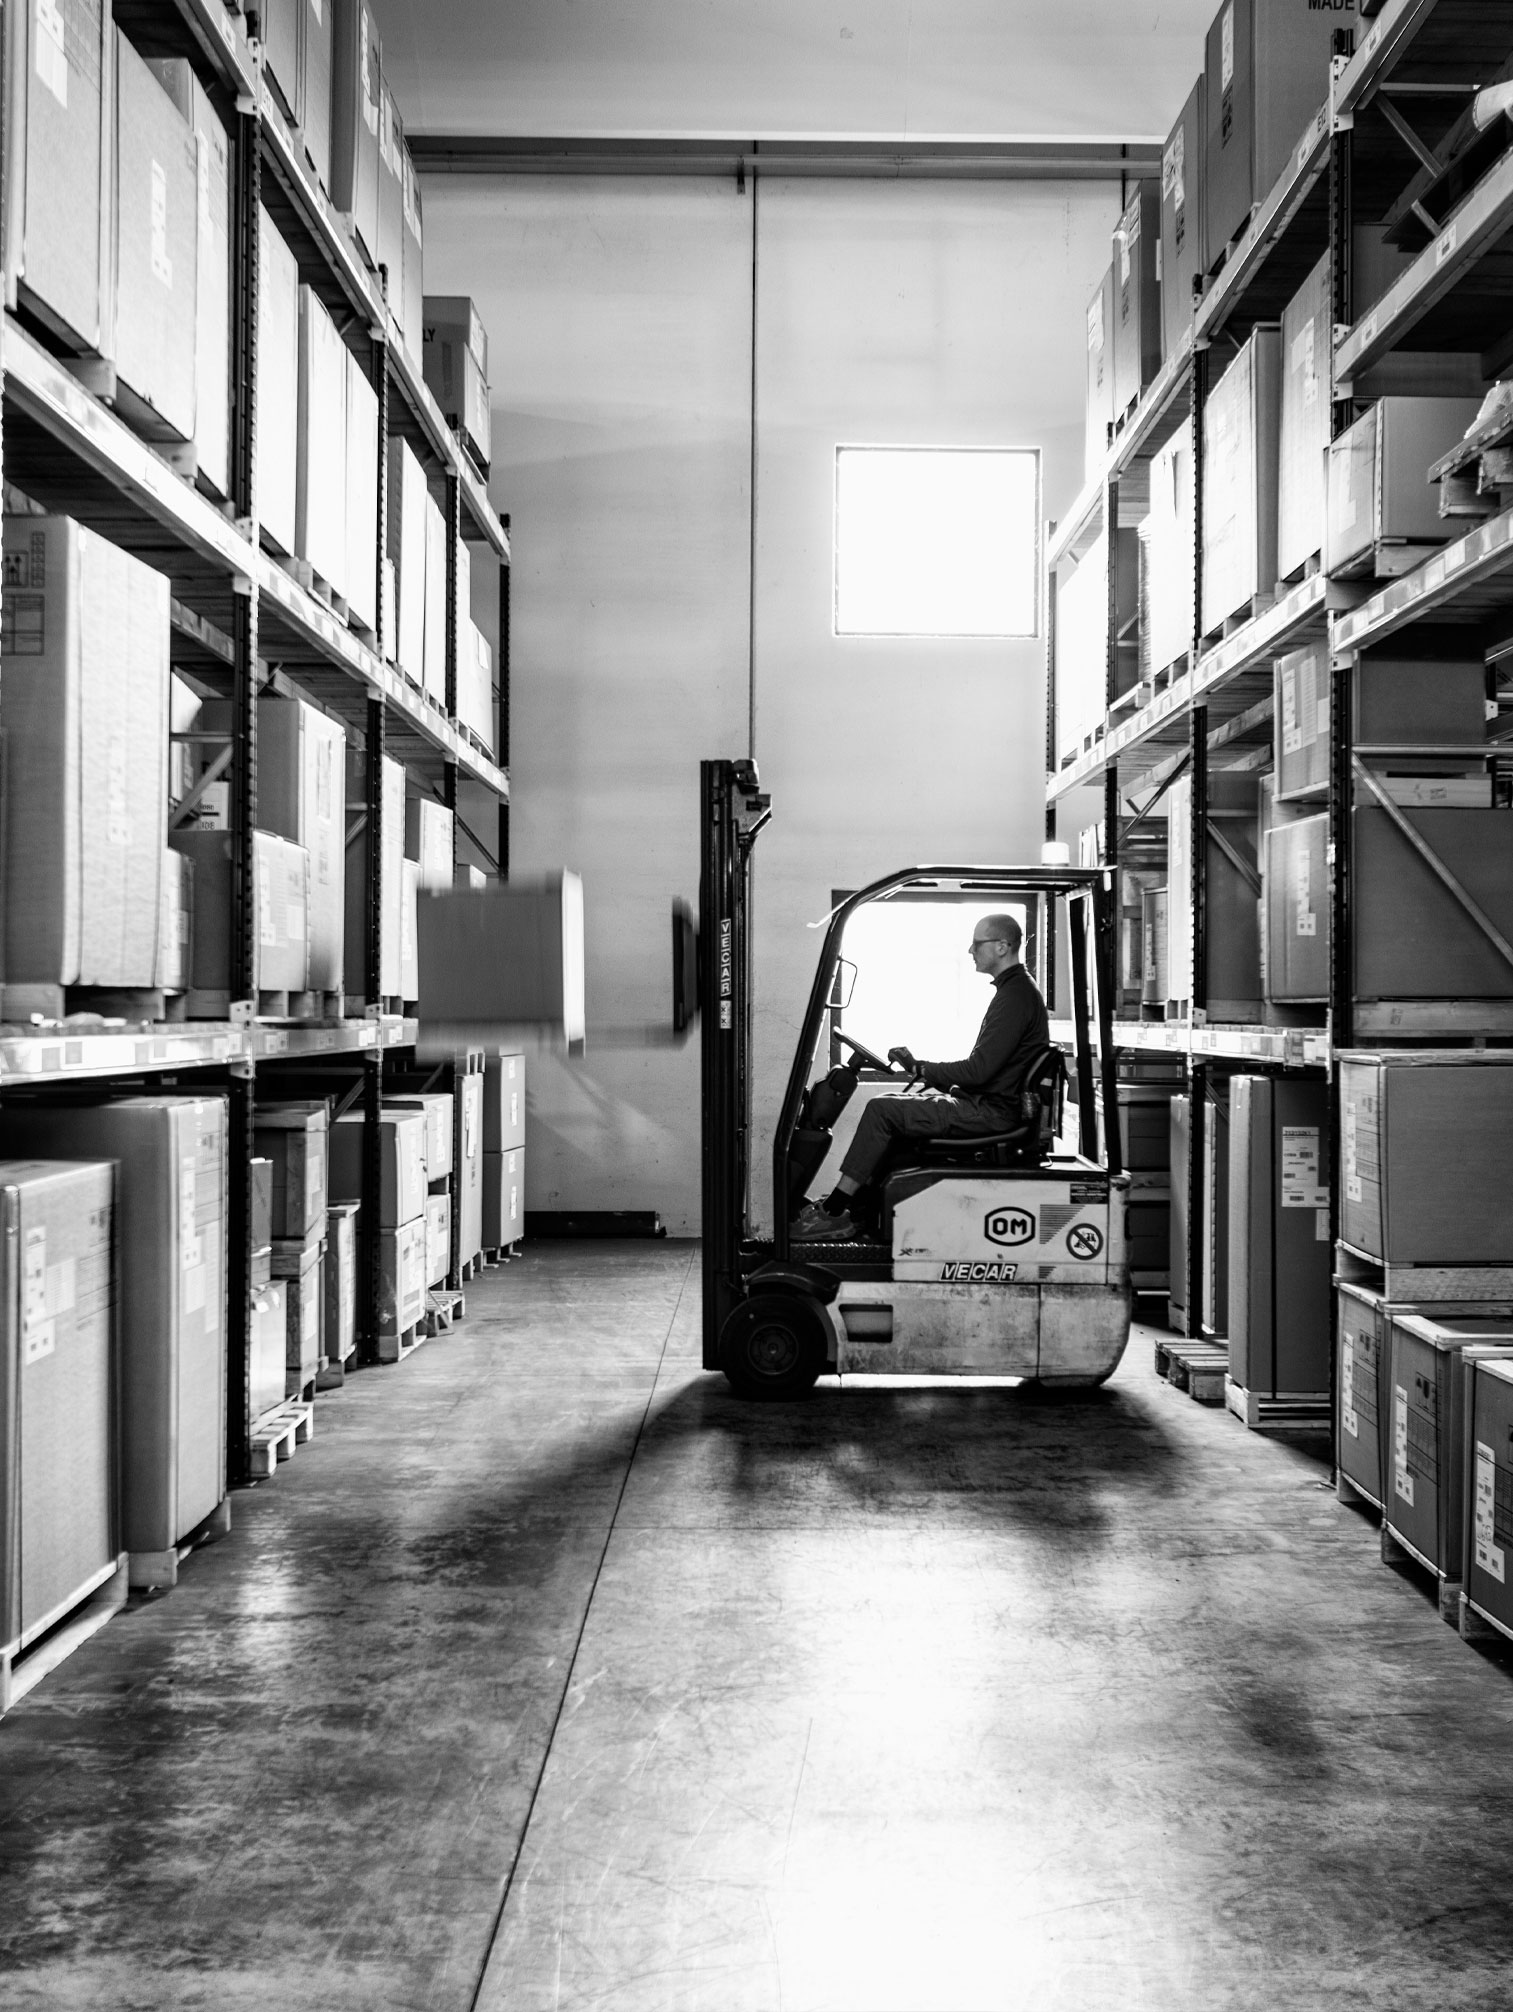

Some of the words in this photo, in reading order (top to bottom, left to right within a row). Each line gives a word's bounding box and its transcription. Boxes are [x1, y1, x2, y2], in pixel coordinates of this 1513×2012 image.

[1308, 0, 1355, 10] MADE
[721, 921, 731, 994] VECAR
[992, 1217, 1028, 1236] OM
[943, 1263, 1017, 1280] VECAR
